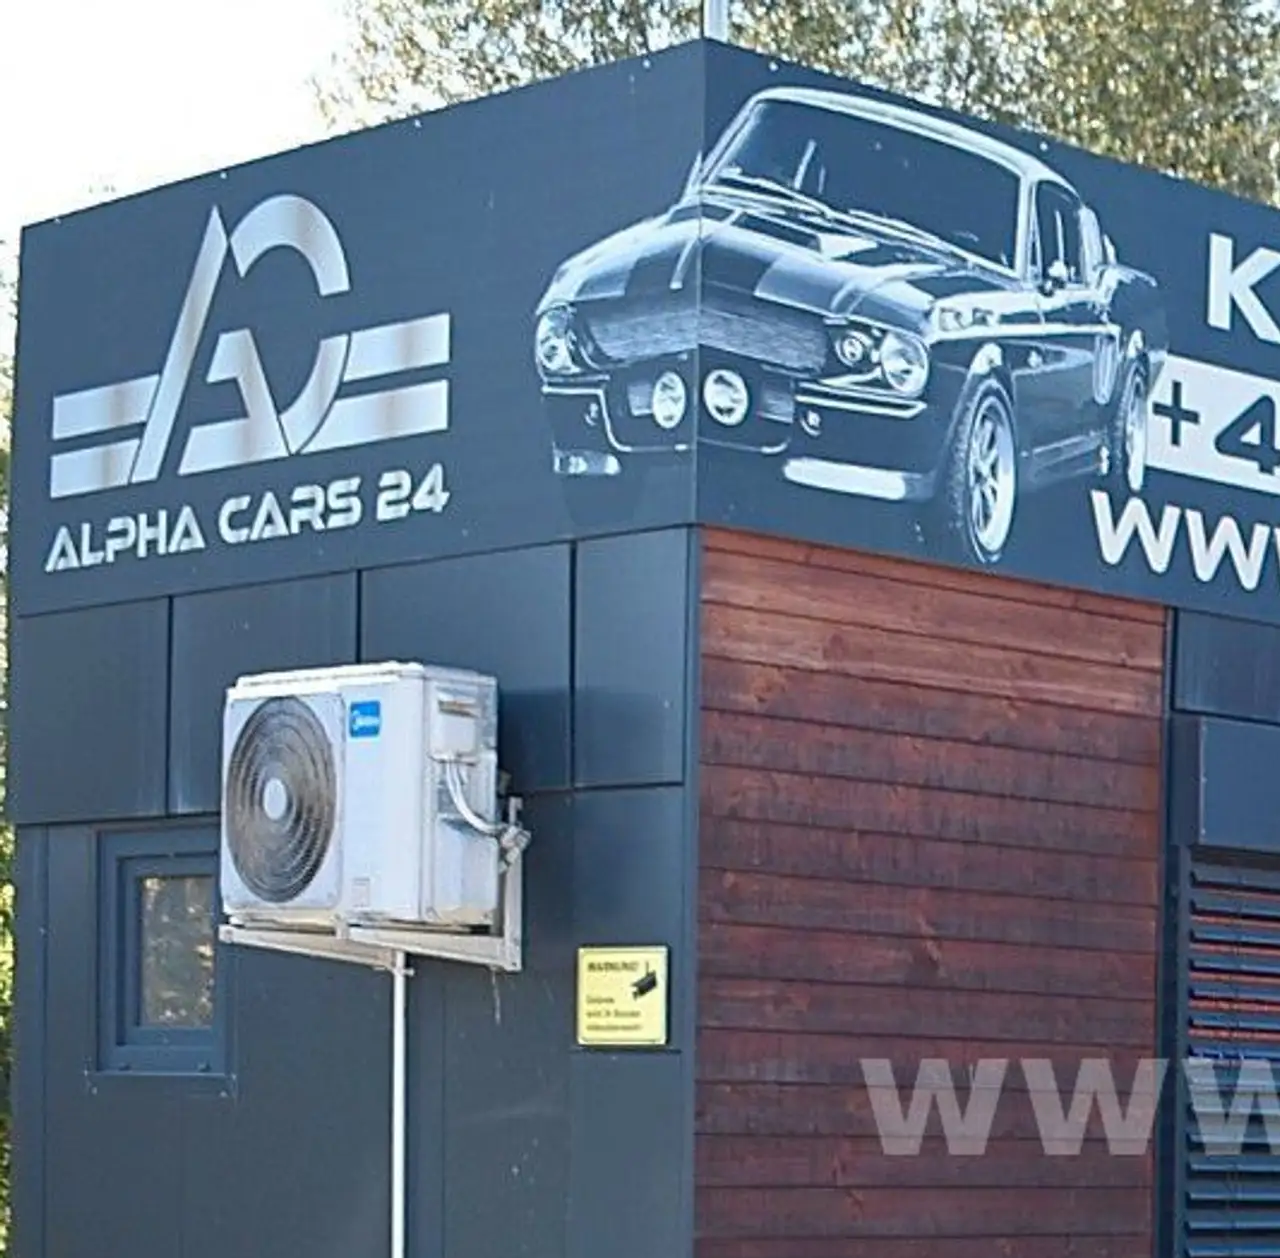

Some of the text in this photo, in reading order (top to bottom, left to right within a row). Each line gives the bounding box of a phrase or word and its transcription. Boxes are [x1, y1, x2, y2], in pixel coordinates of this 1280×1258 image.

[44, 463, 451, 573] ALPHA CARS 24
